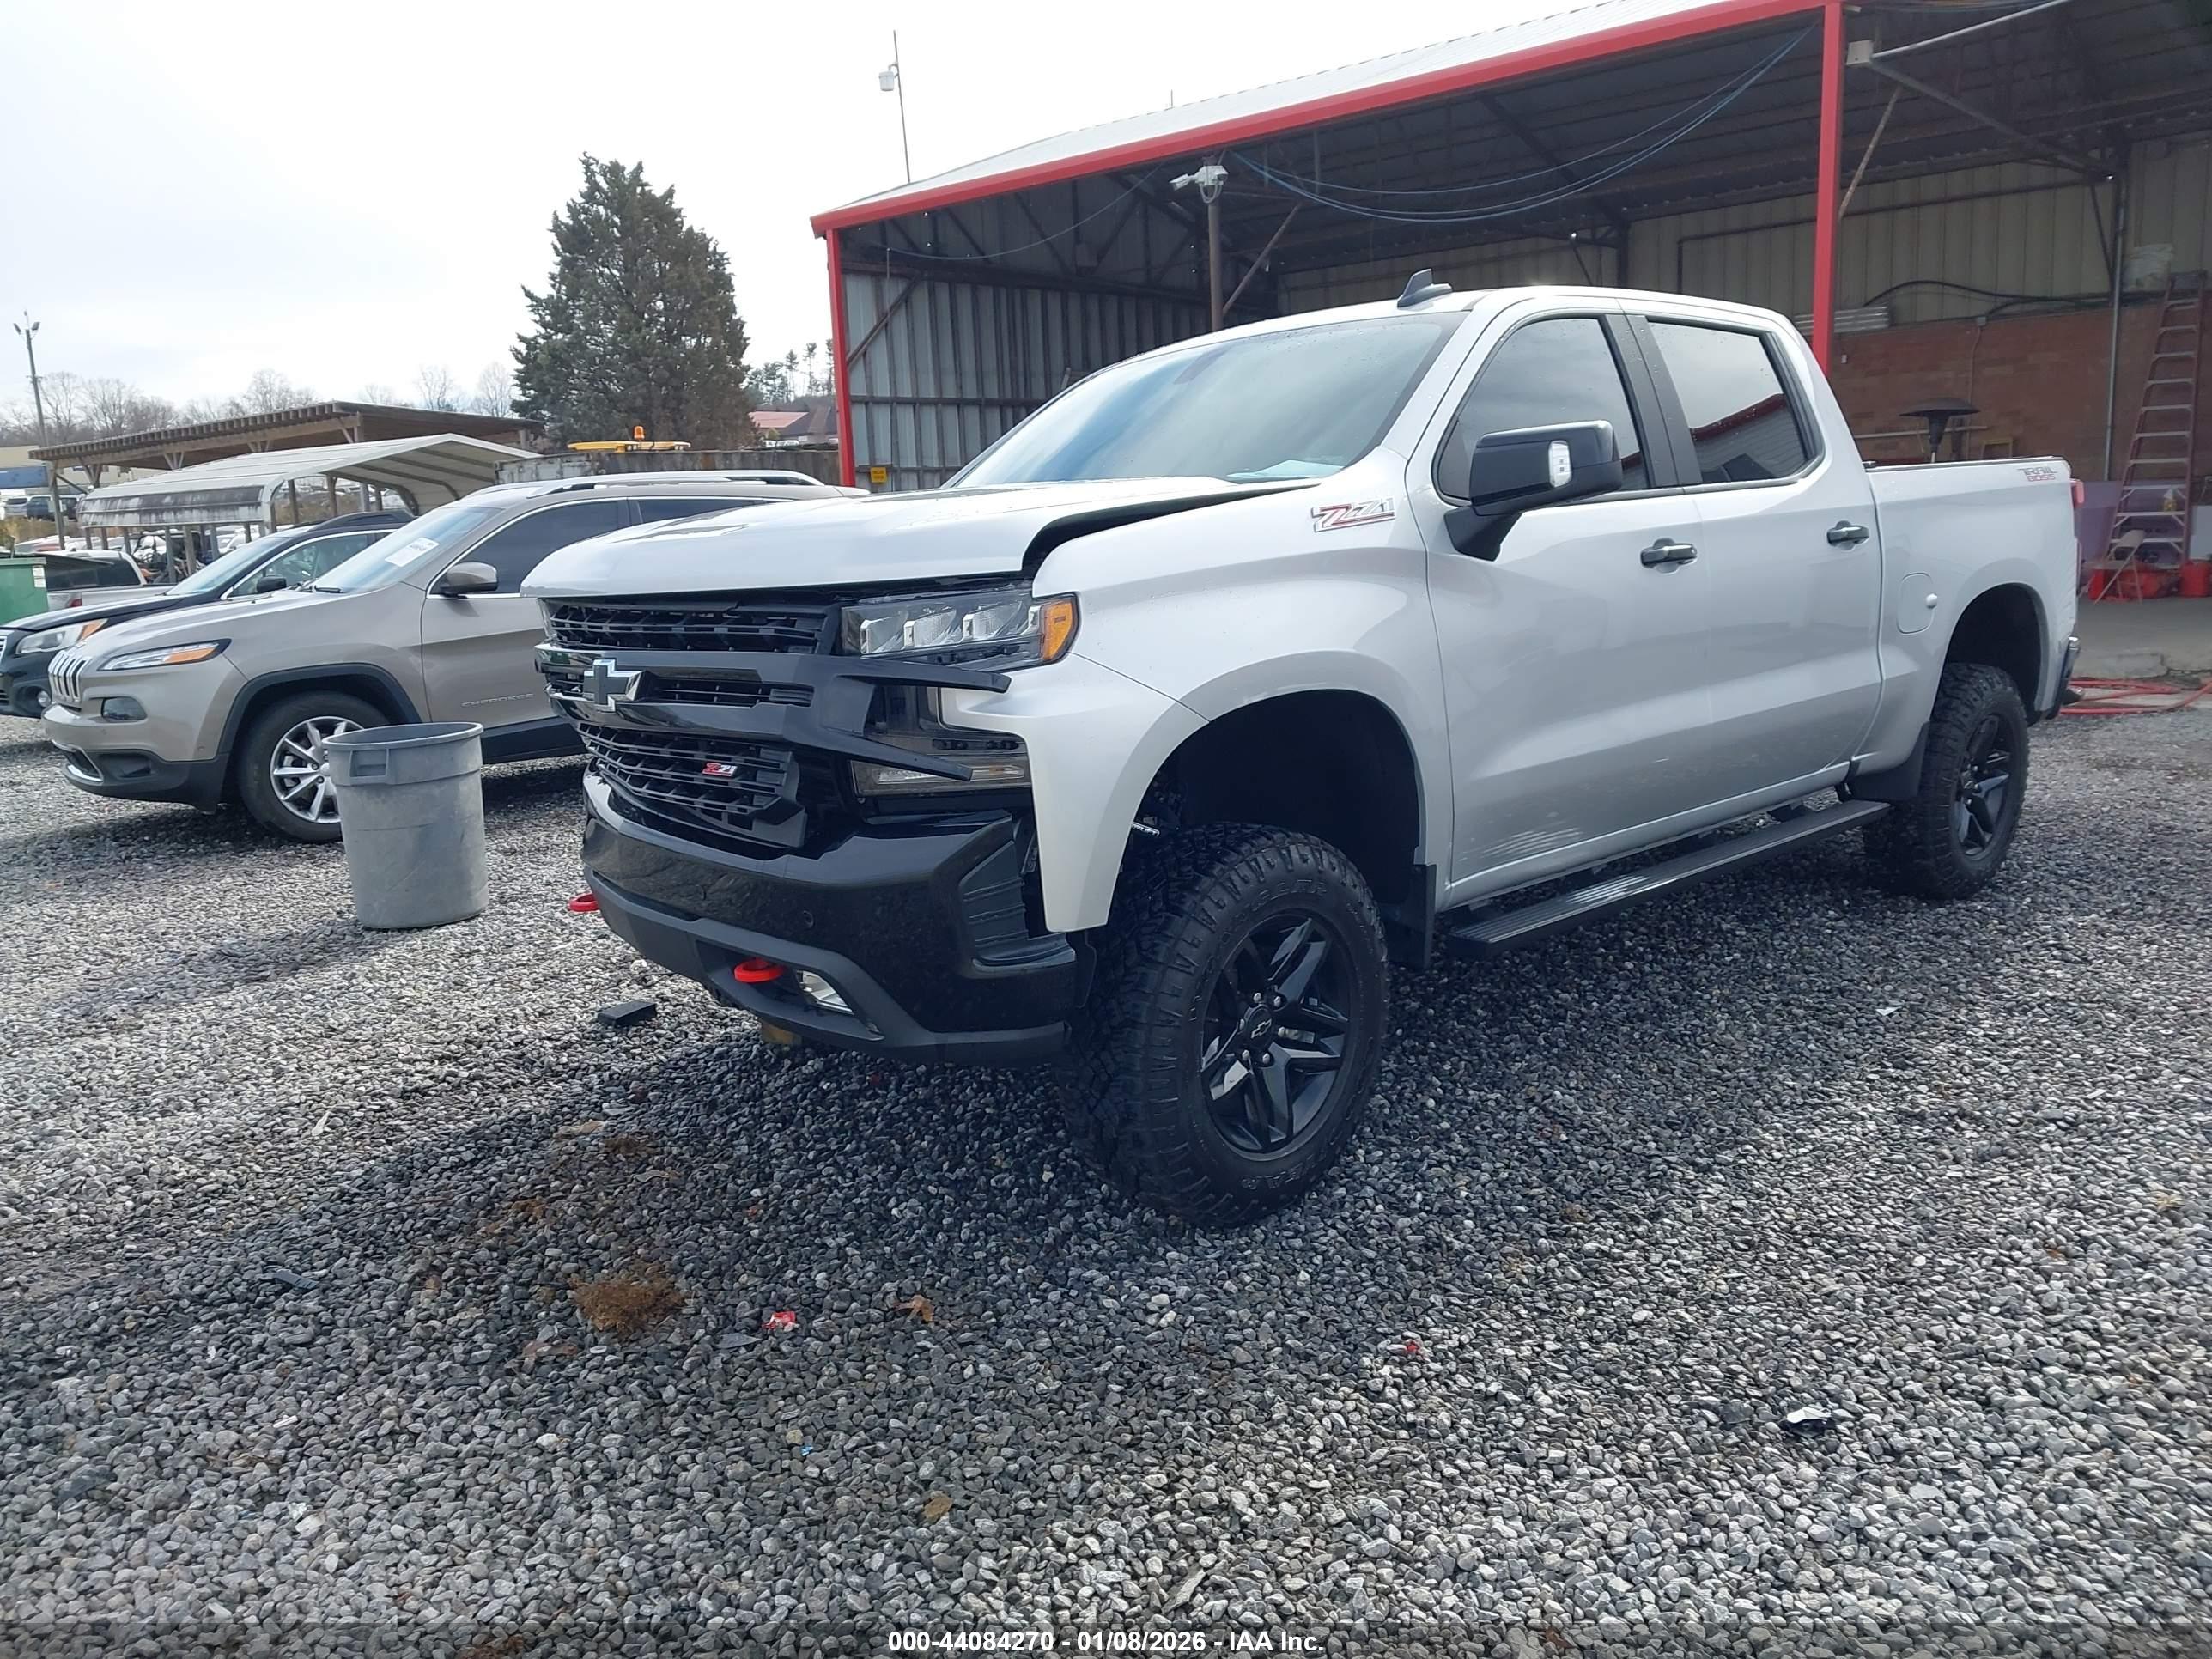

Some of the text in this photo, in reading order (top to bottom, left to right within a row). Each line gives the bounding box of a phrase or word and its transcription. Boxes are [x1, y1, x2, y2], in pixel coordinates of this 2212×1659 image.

[2016, 466, 2059, 476] TRAIL
[1310, 497, 1395, 533] Z71
[702, 761, 738, 777] Z71
